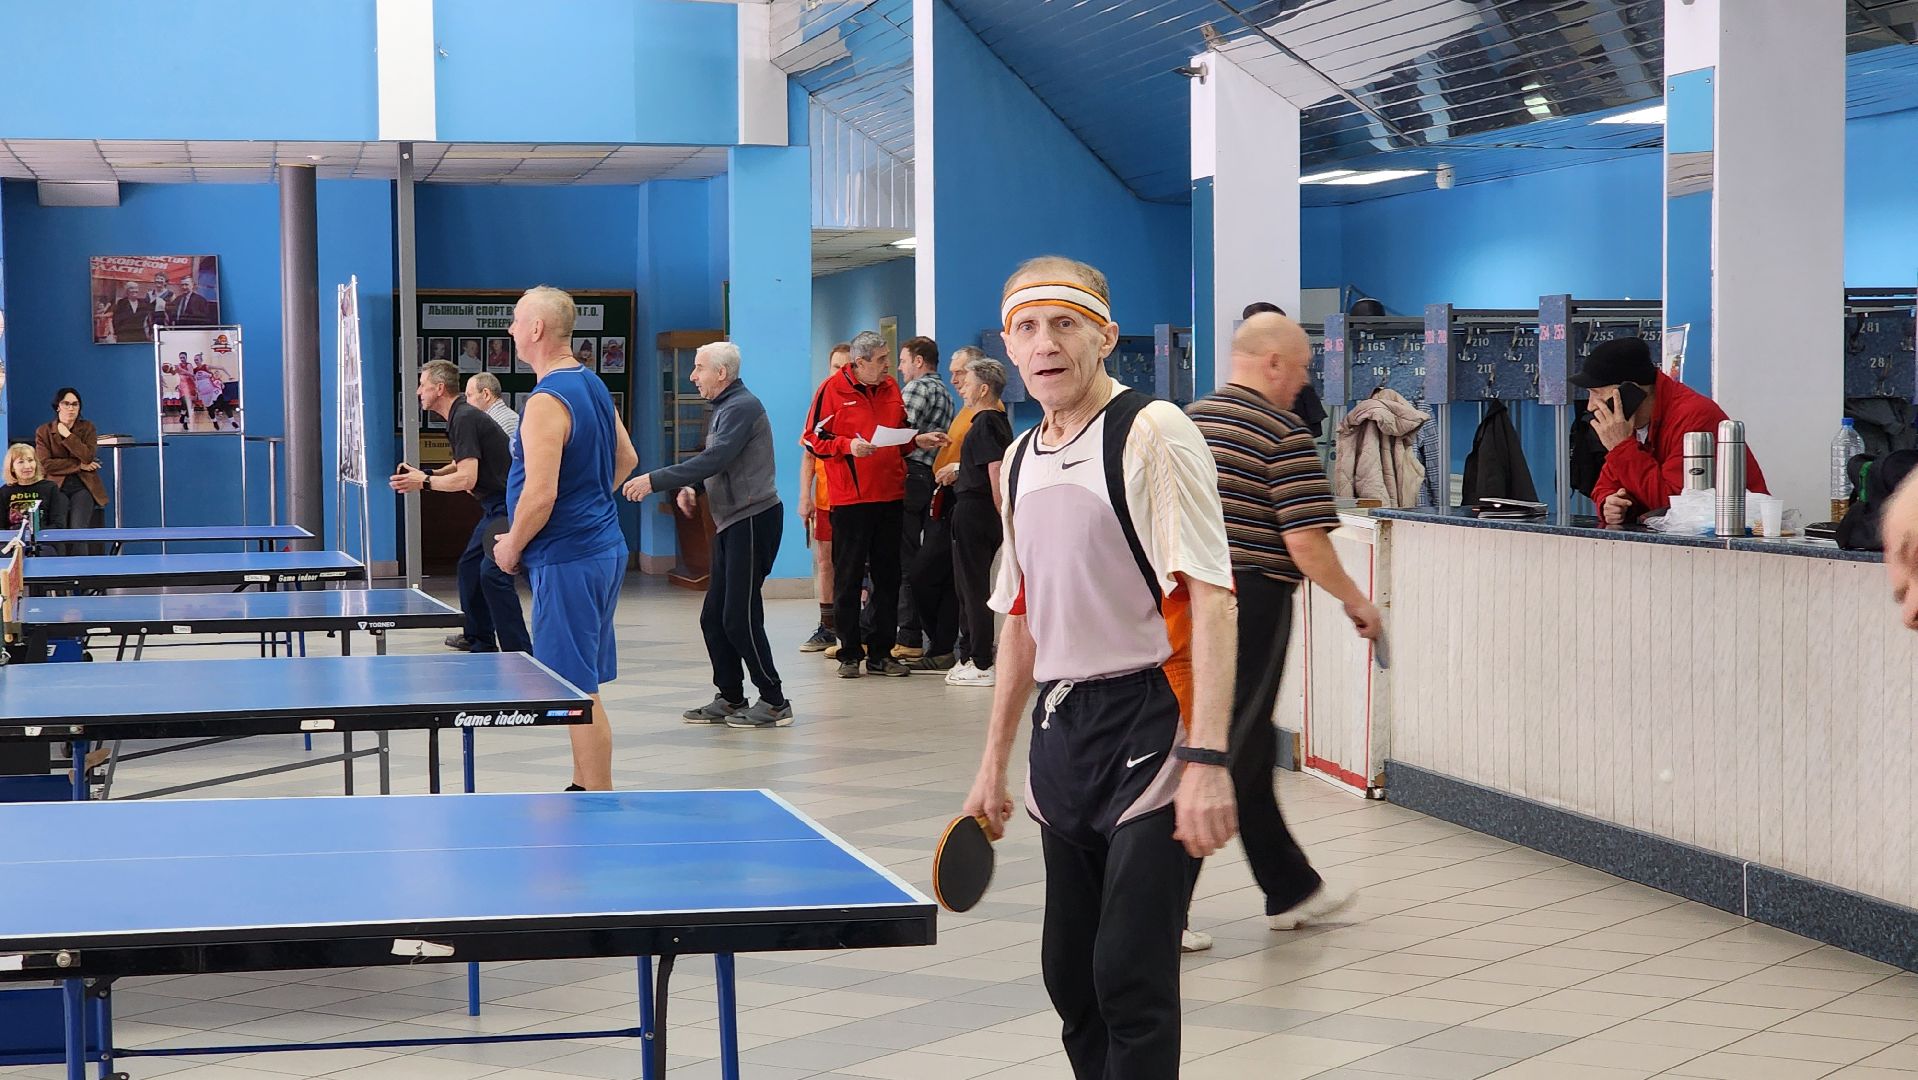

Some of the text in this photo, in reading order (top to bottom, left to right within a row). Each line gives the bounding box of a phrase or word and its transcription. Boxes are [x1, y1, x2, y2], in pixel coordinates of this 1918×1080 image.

[428, 304, 474, 315] ЛЫЖНЫЙ
[476, 306, 504, 316] СПОРТ
[1592, 331, 1614, 341] 255
[1642, 331, 1662, 341] 257
[1367, 342, 1386, 352] 165
[1472, 338, 1490, 347] 210
[1518, 338, 1535, 347] 212
[1414, 367, 1426, 376] 16
[1523, 363, 1538, 373] 21
[279, 574, 296, 582] Game
[298, 573, 318, 582] indoor
[369, 621, 395, 629] TORNEO
[454, 711, 493, 727] Game
[495, 709, 539, 726] indoor
